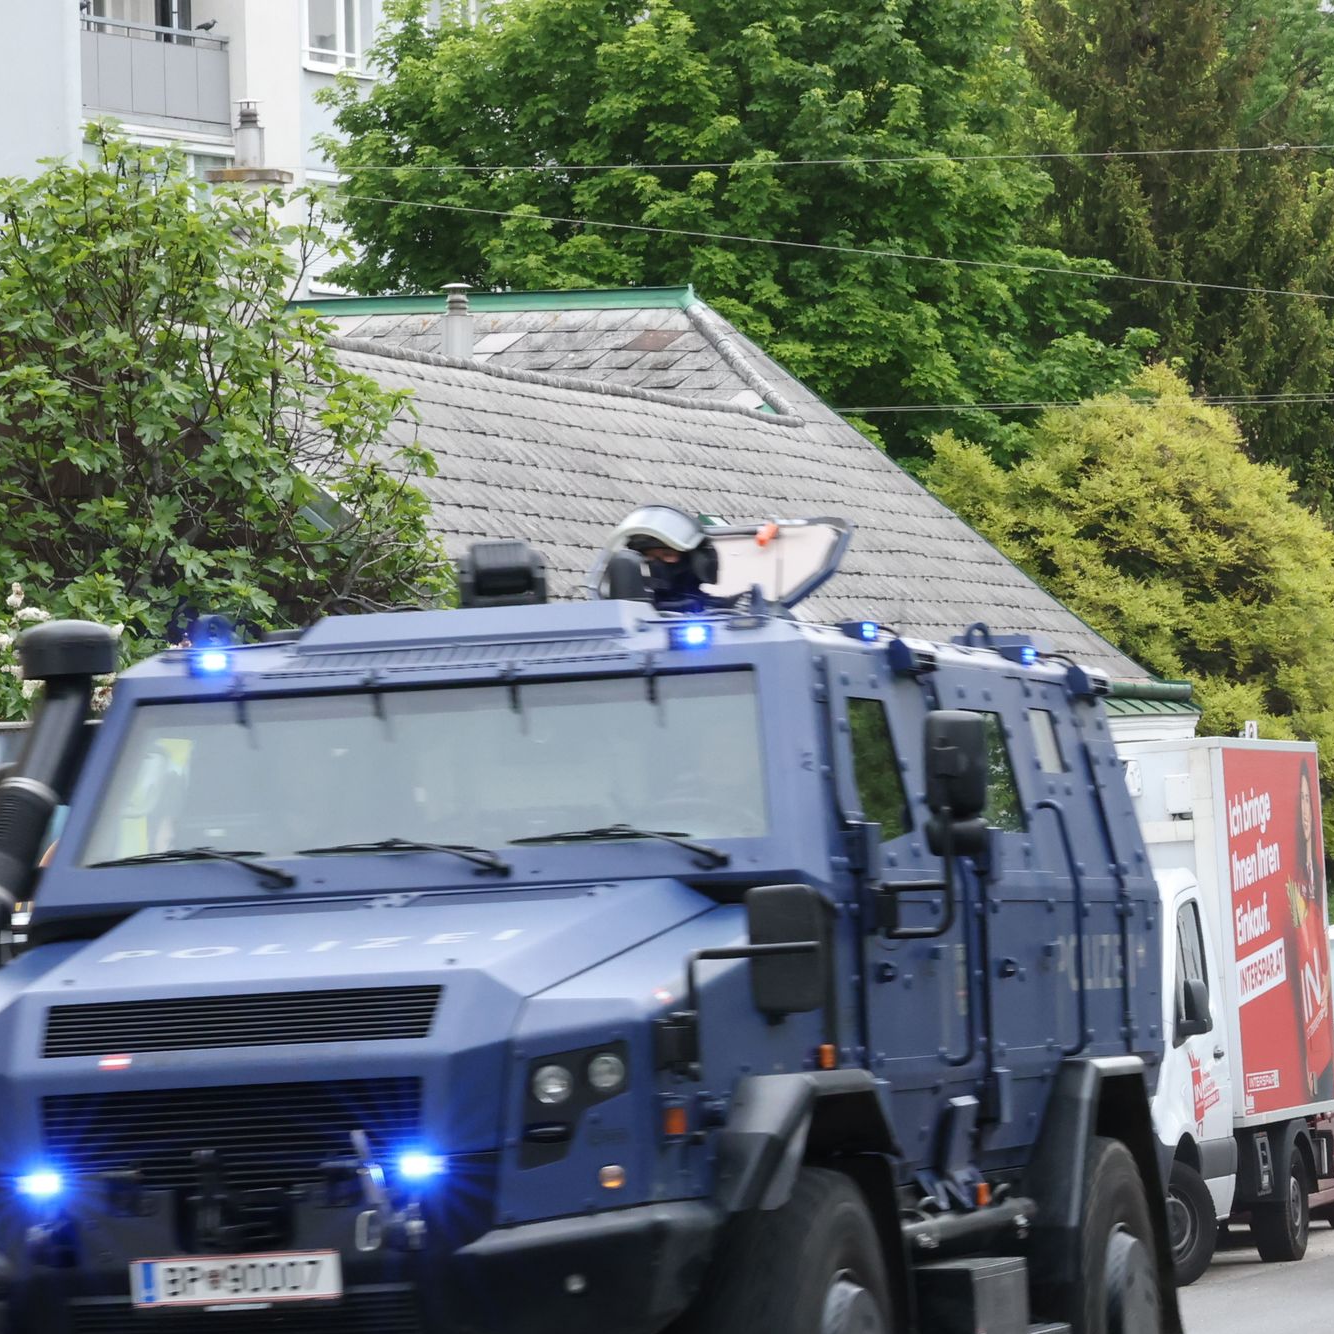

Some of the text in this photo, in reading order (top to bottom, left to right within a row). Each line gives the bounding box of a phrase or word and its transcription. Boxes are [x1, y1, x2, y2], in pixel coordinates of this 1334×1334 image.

[1228, 787, 1271, 838] Ich bringe
[1232, 838, 1280, 893] Ihnen Ihren
[1235, 891, 1271, 946] Einkauf.
[98, 928, 525, 964] POLIZEI
[1239, 947, 1284, 997] INTERSPAR.AT
[164, 1259, 323, 1297] BP 90007
